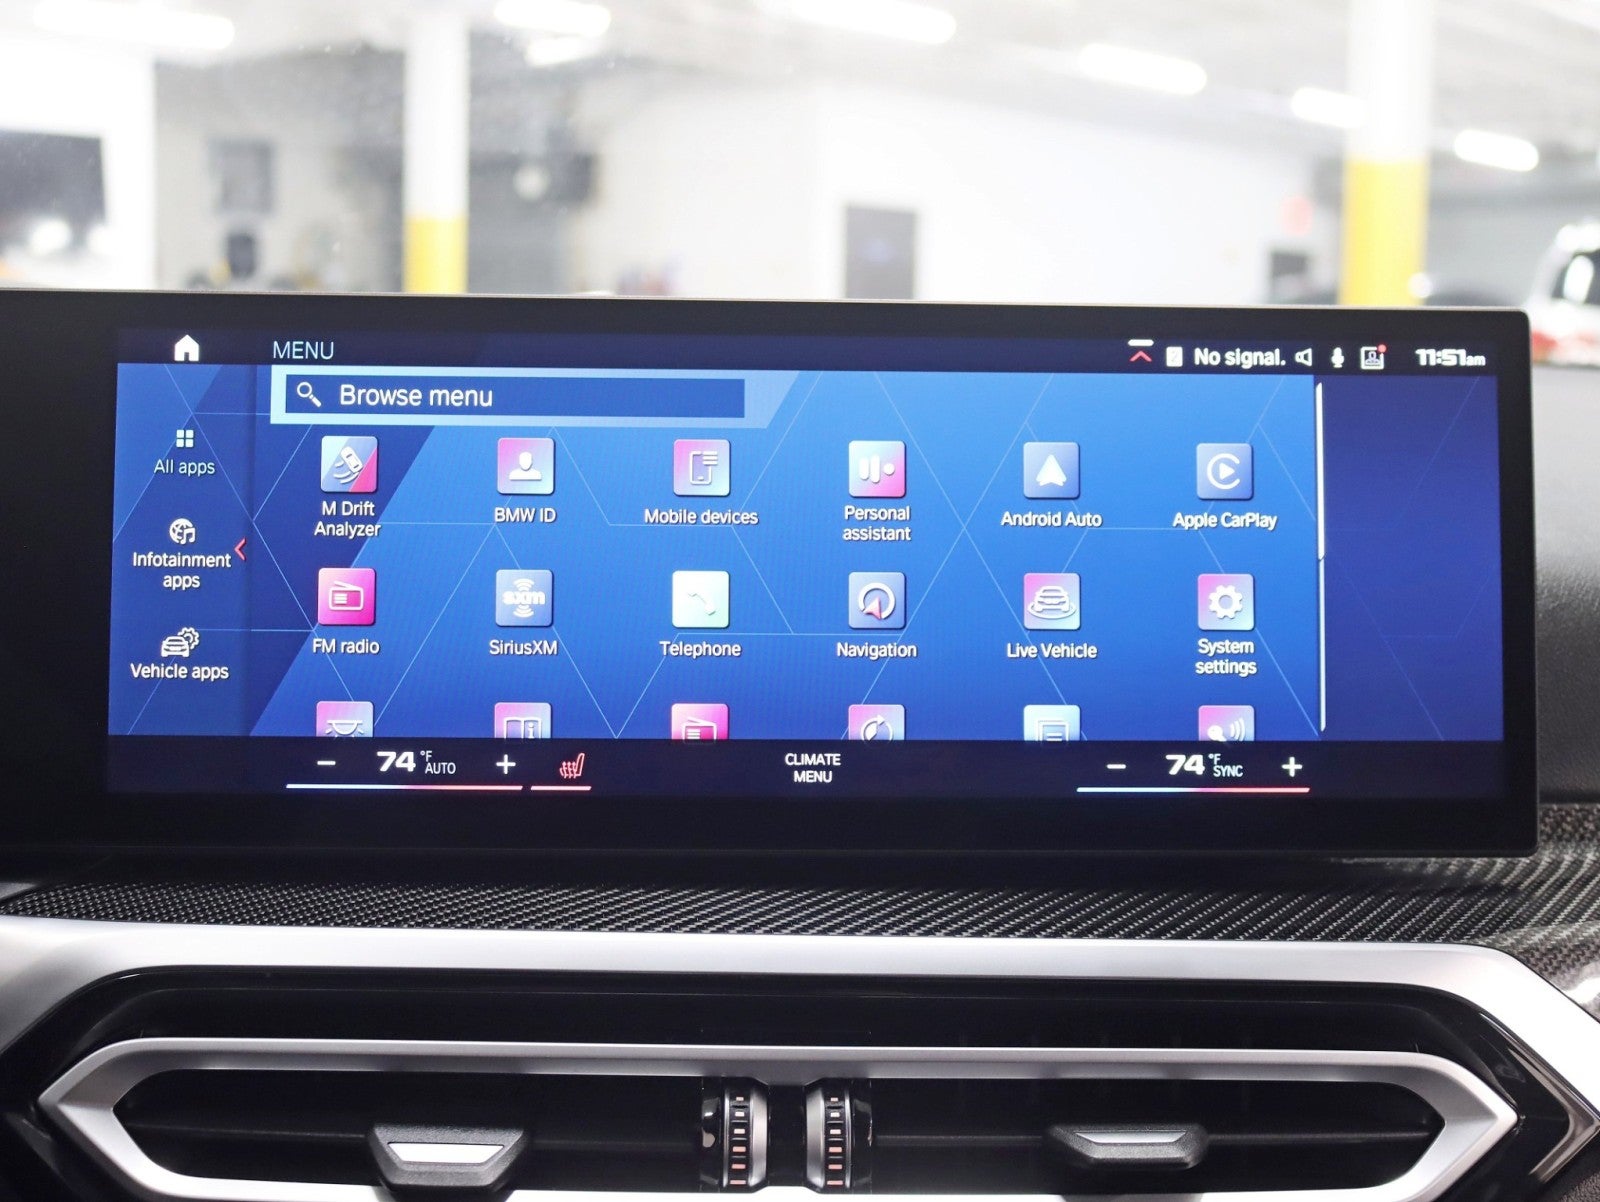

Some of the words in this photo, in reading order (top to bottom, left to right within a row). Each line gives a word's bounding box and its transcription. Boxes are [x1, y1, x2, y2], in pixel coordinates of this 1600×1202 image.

[273, 341, 334, 360] MENU
[1194, 347, 1220, 366] No
[1225, 347, 1286, 369] signal.
[340, 384, 422, 407] Browse
[429, 386, 493, 407] menu
[154, 459, 175, 475] All
[178, 462, 216, 476] apps
[322, 501, 336, 517] M
[341, 500, 375, 517] Drift
[494, 508, 535, 523] BMW
[539, 508, 556, 523] ID
[644, 509, 697, 525] Mobile
[701, 509, 758, 525] devices
[844, 506, 911, 521] Personal
[1001, 511, 1061, 528] Android
[1065, 512, 1103, 528] Auto
[1172, 512, 1217, 530] Apple
[1220, 512, 1278, 531] CarPlay
[314, 521, 381, 538] Analyzer
[843, 526, 911, 542] assistant
[133, 552, 231, 568] Infotainment
[163, 574, 201, 590] apps
[312, 639, 336, 654] FM
[340, 639, 380, 655] radio
[489, 640, 557, 656] SiriusXM
[660, 641, 742, 658] Telephone
[837, 642, 917, 659] Navigation
[1007, 643, 1037, 659] Live
[1041, 642, 1098, 659] Vehicle
[1198, 639, 1254, 656] System
[130, 664, 188, 679] Vehicle
[192, 665, 229, 681] apps
[1195, 660, 1257, 677] settings
[376, 751, 416, 773] 74
[424, 762, 457, 775] AUTO
[785, 753, 841, 767] CLIMATE
[1166, 754, 1206, 776] 74
[794, 770, 833, 784] MENU
[1213, 765, 1244, 778] SYNC
